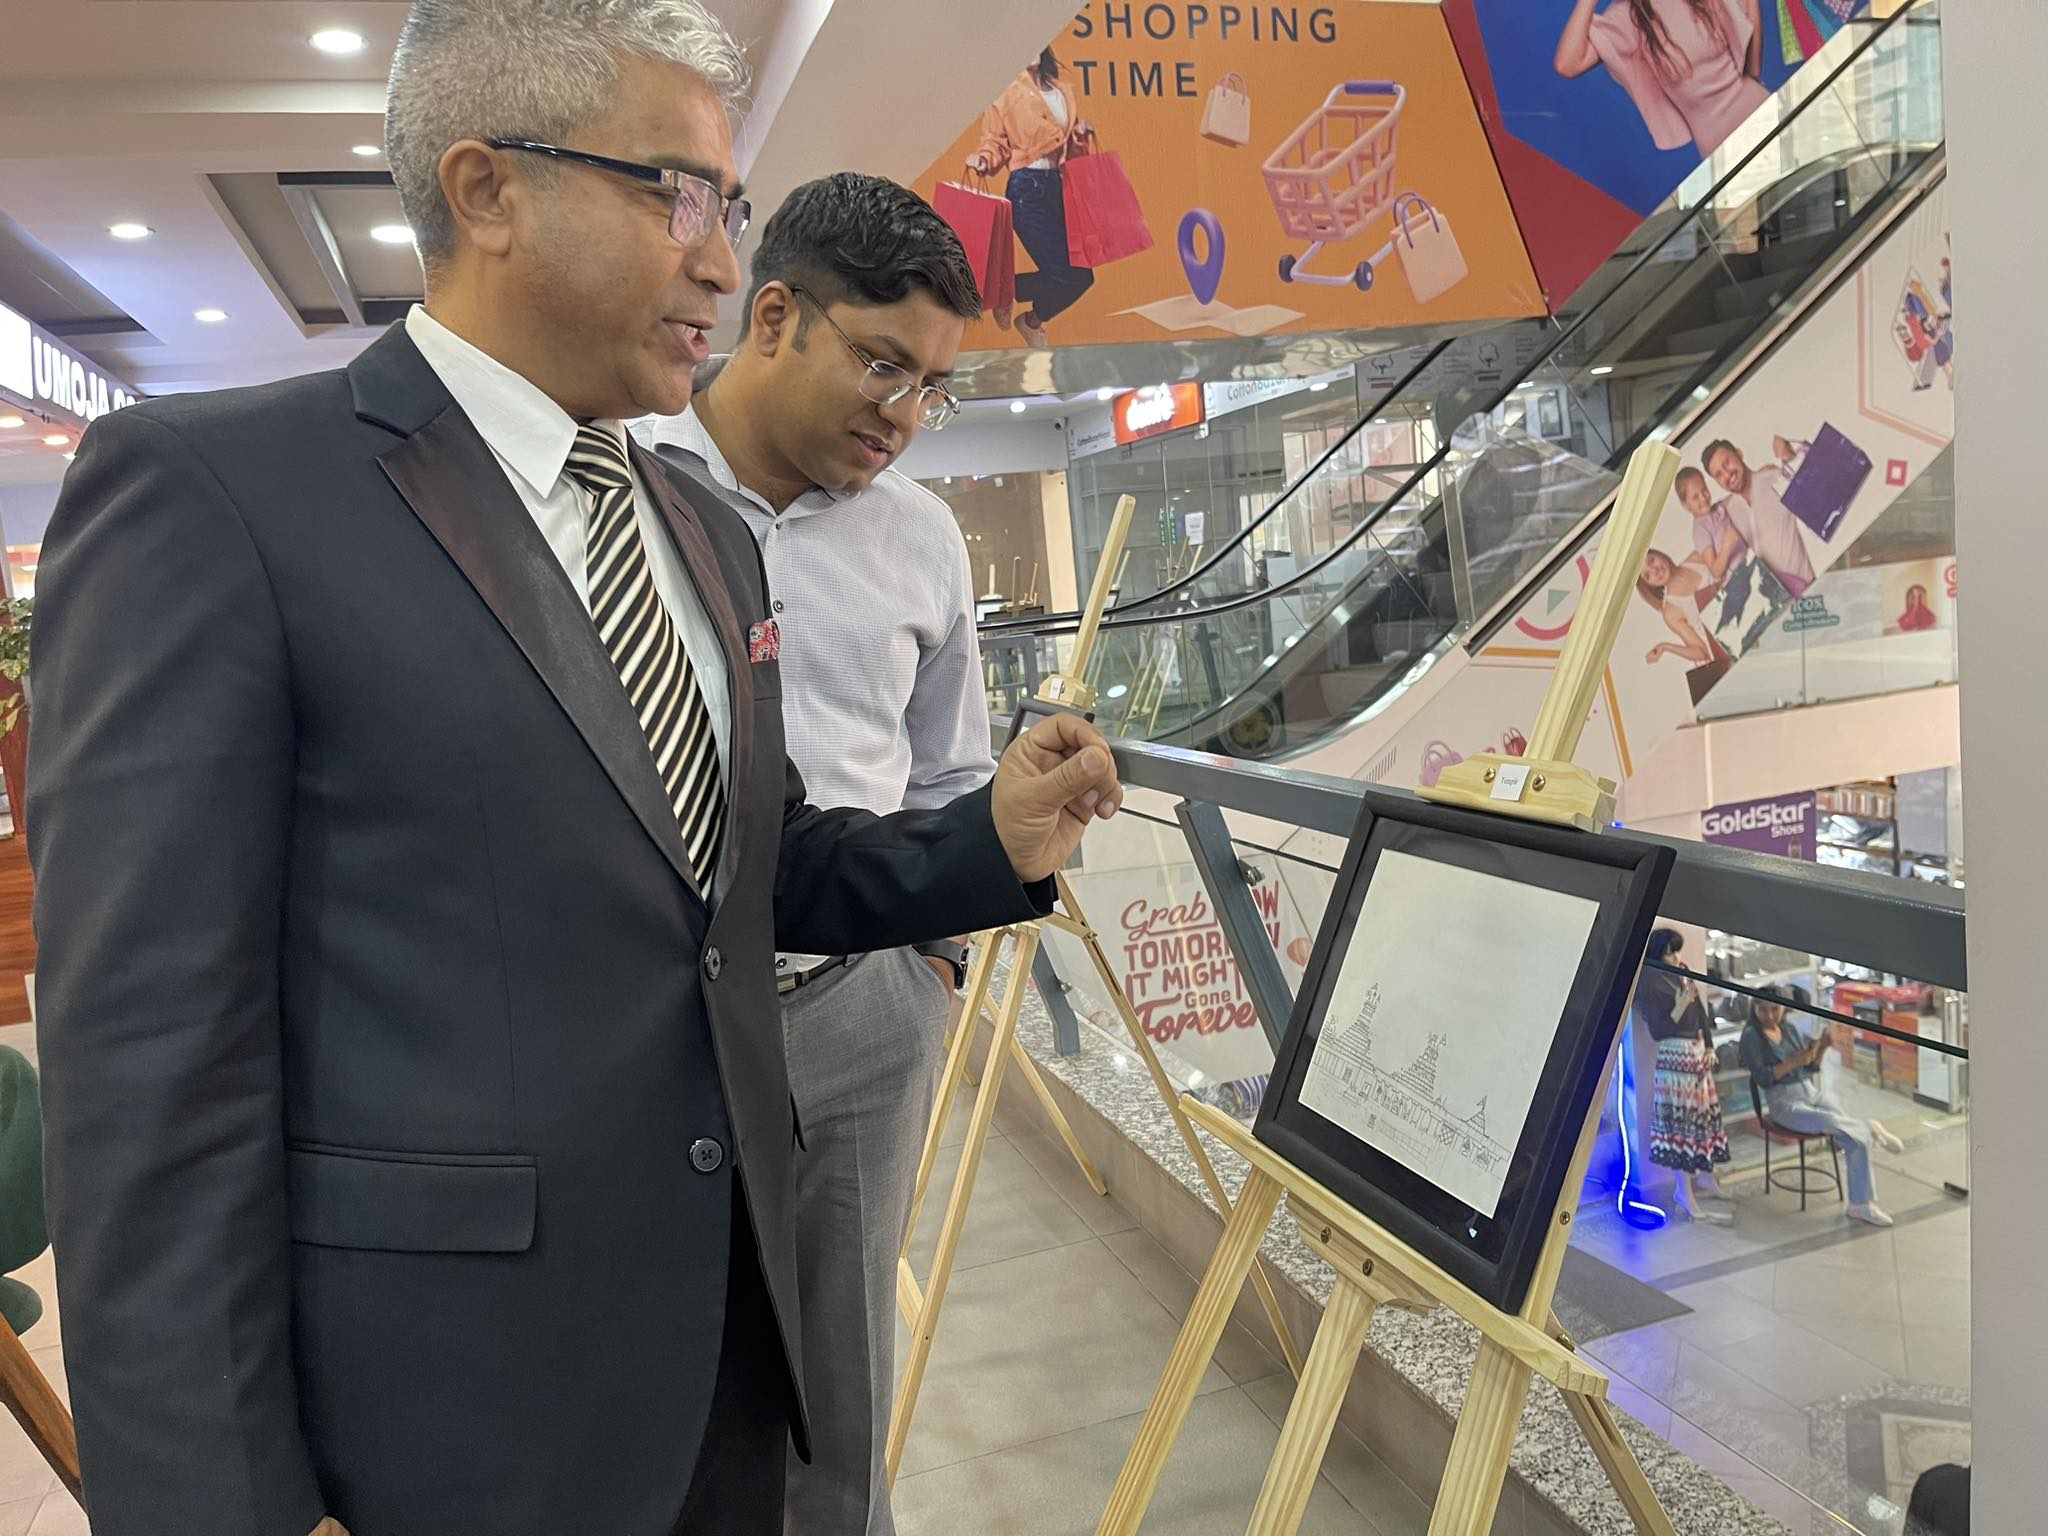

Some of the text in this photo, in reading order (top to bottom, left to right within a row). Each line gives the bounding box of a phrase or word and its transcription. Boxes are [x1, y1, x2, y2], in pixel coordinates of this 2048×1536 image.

[1073, 3, 1338, 44] SHOPPING
[1073, 60, 1199, 98] TIME
[32, 335, 110, 422] UMOJA
[1702, 801, 1811, 836] GoldStar
[1771, 823, 1805, 838] Shoes
[1121, 890, 1207, 942] Grab
[1125, 972, 1152, 1008] IT
[1184, 990, 1231, 1009] Gone
